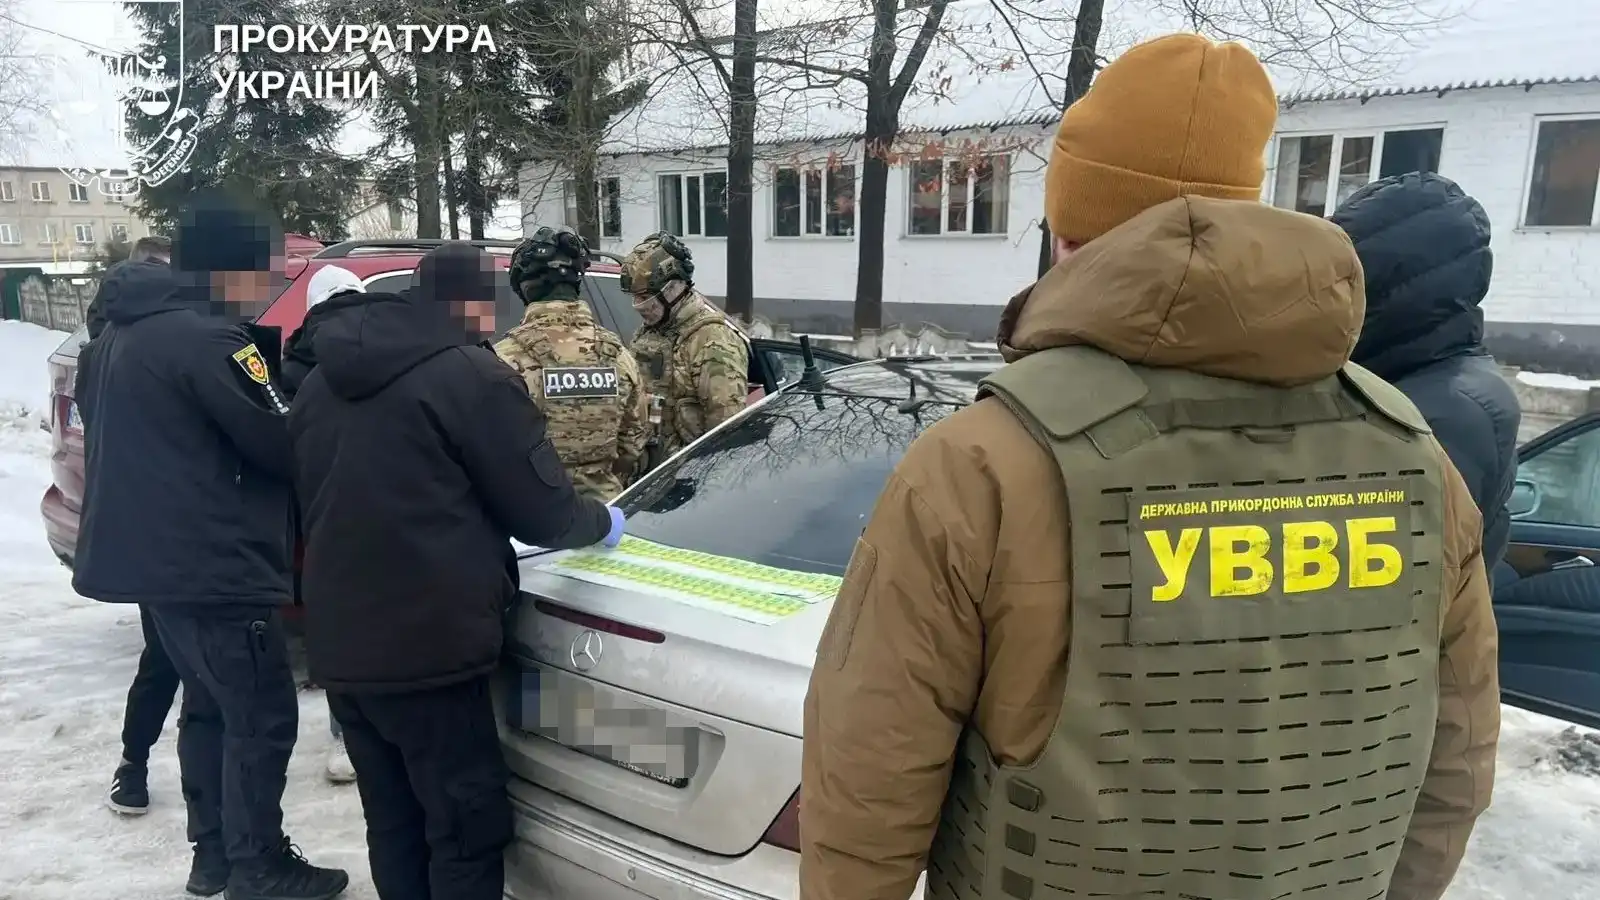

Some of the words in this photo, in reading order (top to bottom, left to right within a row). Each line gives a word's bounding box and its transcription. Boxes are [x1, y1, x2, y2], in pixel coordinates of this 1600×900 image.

[1140, 500, 1208, 519] ДЕРЖАВНА
[1211, 496, 1304, 514] ПРИКОРДОННА
[1306, 493, 1355, 508] СЛУЖБА
[1357, 489, 1405, 506] УКРАЇНИ
[1143, 516, 1403, 602] УВВБ
